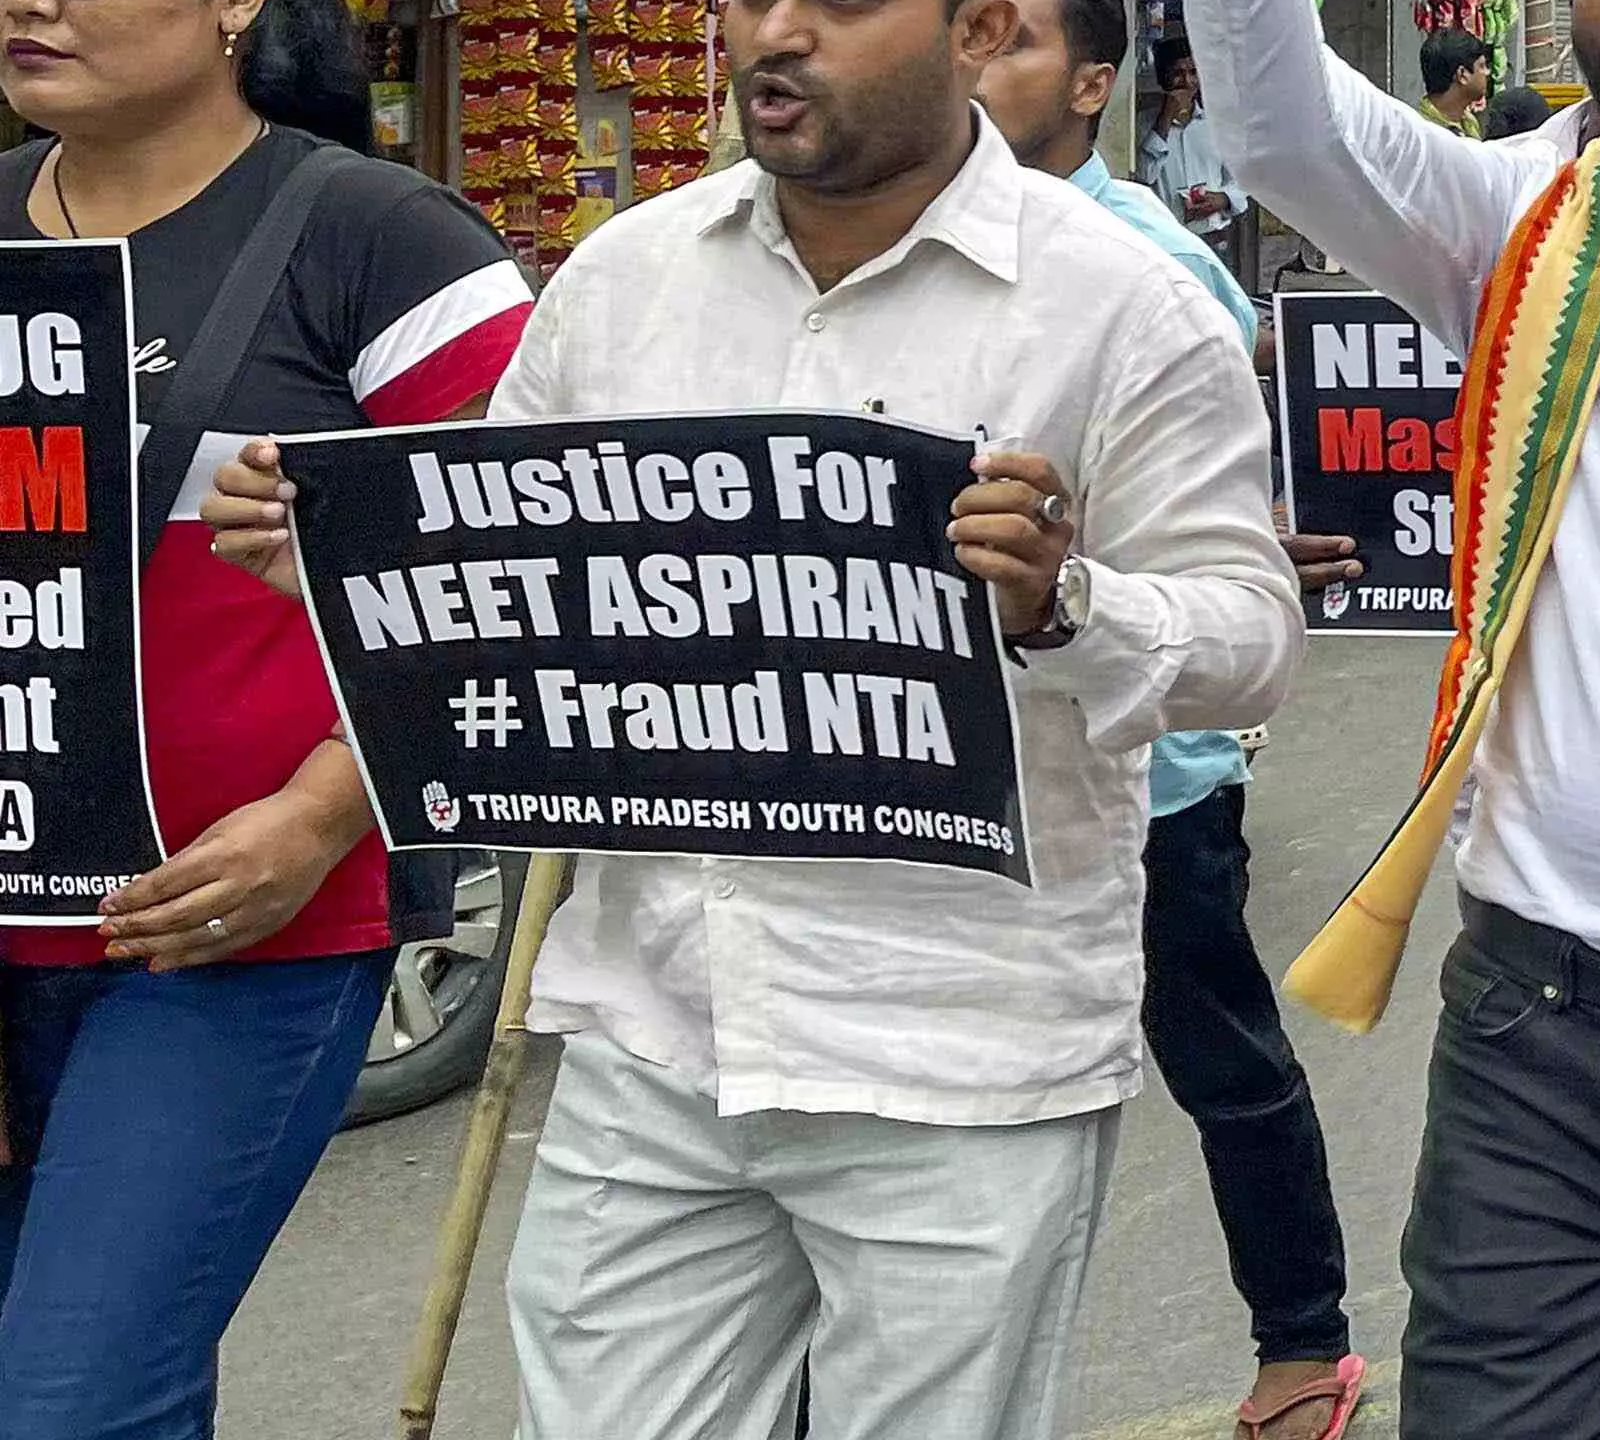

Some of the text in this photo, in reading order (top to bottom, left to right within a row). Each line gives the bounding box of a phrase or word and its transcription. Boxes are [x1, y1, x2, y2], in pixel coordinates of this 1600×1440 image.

[409, 436, 896, 533] Justice For
[343, 553, 974, 658] NEET ASPIRANT
[449, 670, 957, 766] # Fraud NTA
[468, 795, 1015, 856] TRIPURA PRADESH YOUTH CONGRESS
